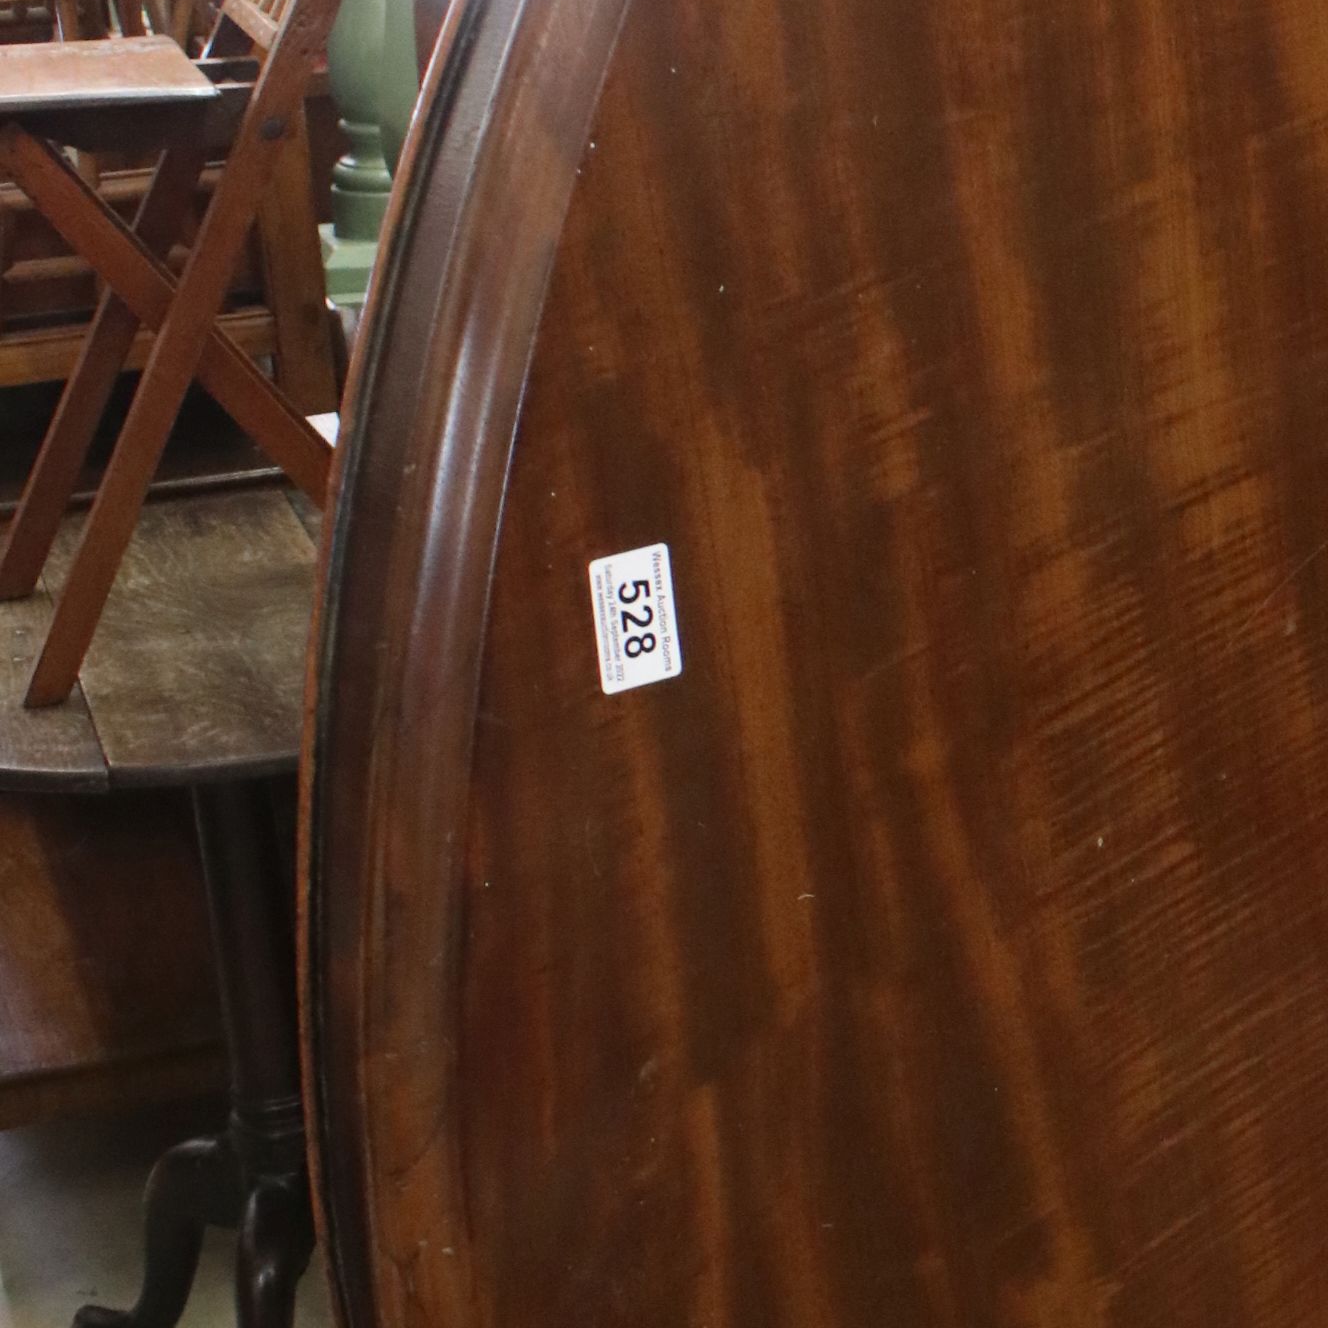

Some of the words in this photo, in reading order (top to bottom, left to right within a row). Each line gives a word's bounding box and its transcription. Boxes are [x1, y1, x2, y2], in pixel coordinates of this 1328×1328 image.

[651, 551, 663, 592] Wessex
[618, 580, 656, 659] 528
[656, 594, 669, 634] Auction
[661, 636, 673, 672] Rooms
